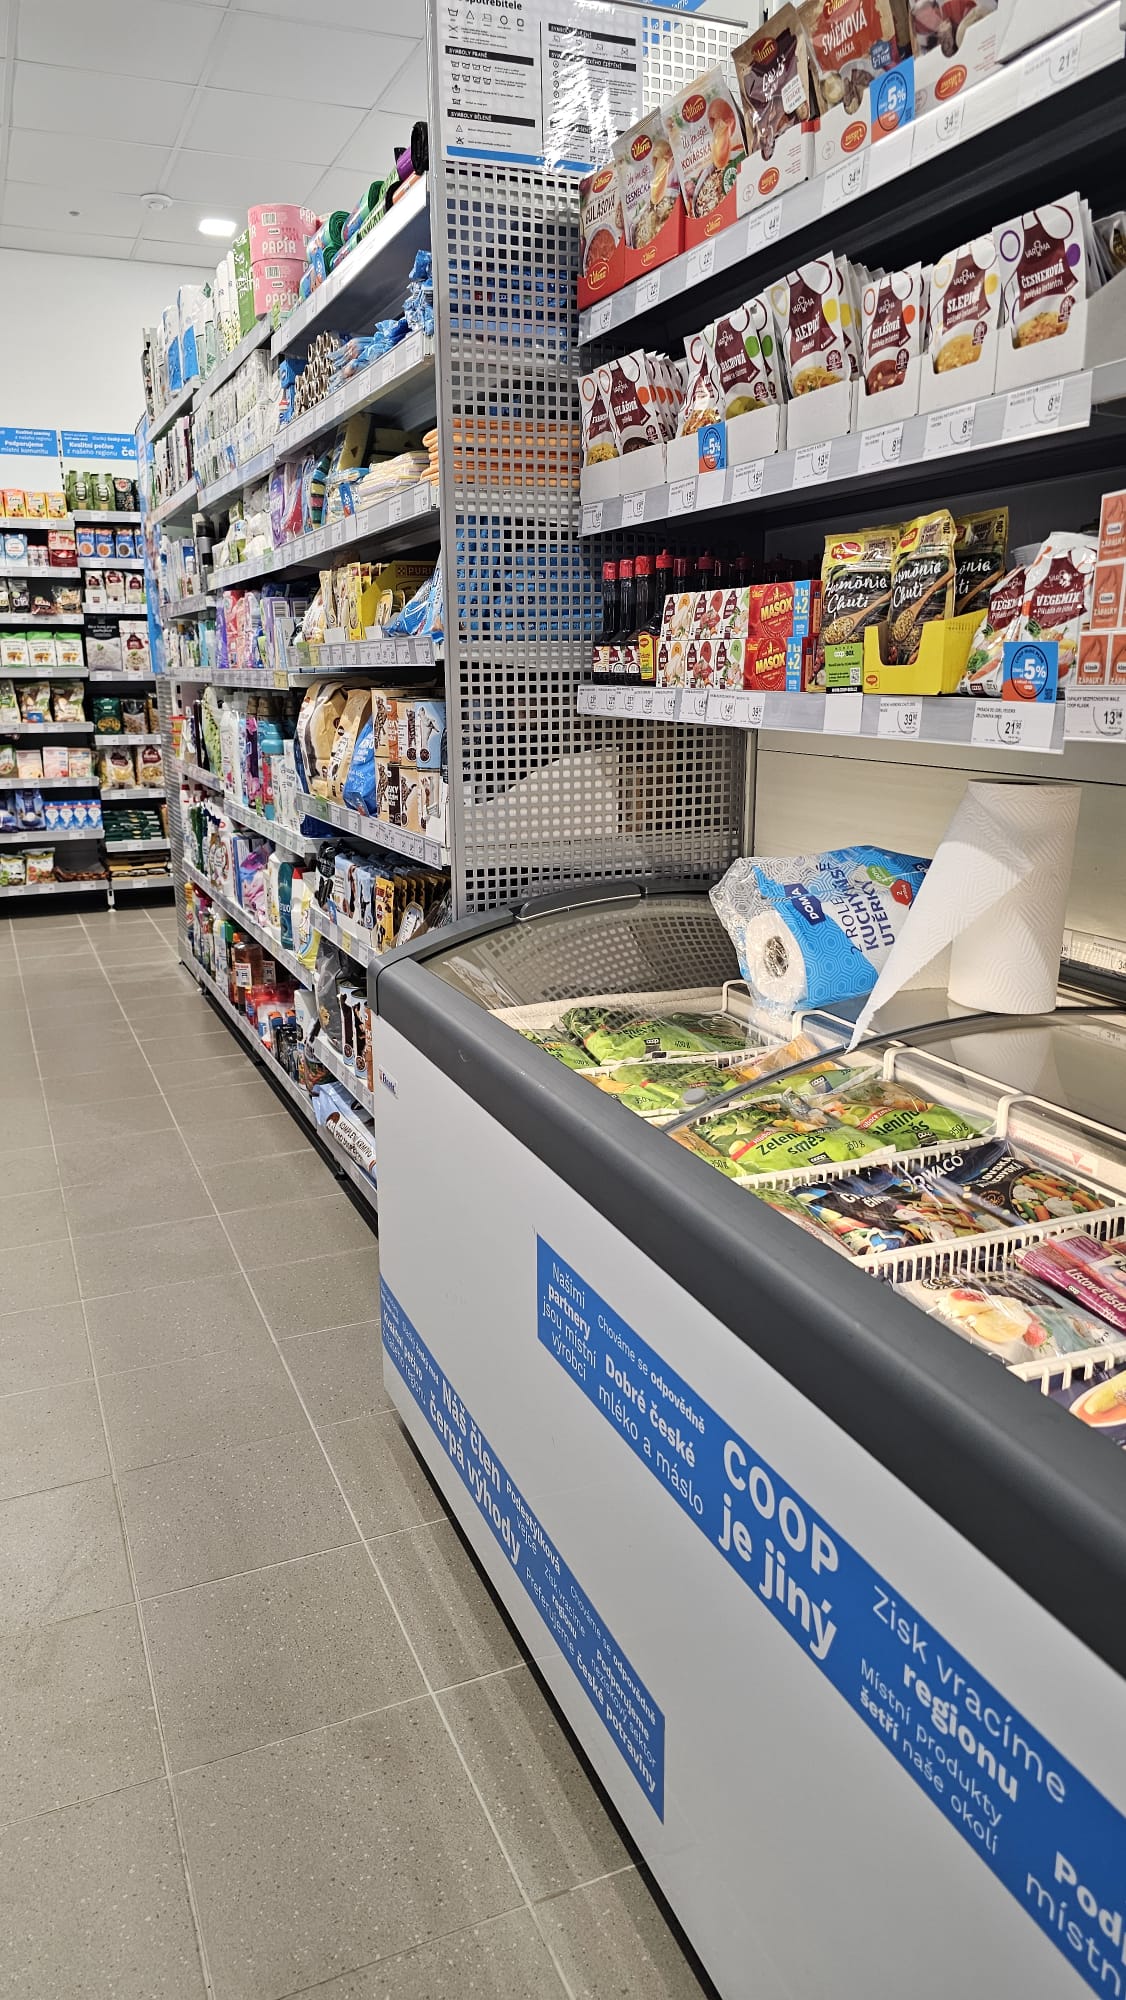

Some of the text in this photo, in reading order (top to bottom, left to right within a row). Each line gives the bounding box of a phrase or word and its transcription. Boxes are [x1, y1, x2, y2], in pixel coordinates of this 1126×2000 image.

[821, 1, 868, 56] SVÍČKOVÁ
[886, 85, 907, 110] 5%
[1021, 257, 1065, 290] ČESNEKOVÁ
[4, 440, 44, 449] Podporujeme
[69, 441, 93, 449] Kvalitní
[408, 566, 432, 575] PURI
[760, 596, 793, 622] MASOX
[795, 596, 809, 615] +2
[828, 593, 869, 614] Chuti
[991, 594, 1025, 611] VEGEM
[1036, 590, 1081, 606] VEGEMIX
[755, 651, 787, 675] MASOX
[787, 653, 800, 670] +2
[1023, 658, 1047, 681] 5%
[791, 887, 820, 921] DOMA
[830, 896, 859, 939] ROLE
[857, 880, 896, 947] UTĚRKY
[850, 943, 864, 955] 2
[787, 1134, 827, 1156] směs
[914, 1153, 965, 1186] OWACO
[547, 1283, 591, 1341] partnery
[551, 1261, 586, 1310] Našimi
[541, 1295, 597, 1369] jsou místní
[551, 1330, 587, 1382] výrobci
[597, 1312, 705, 1435] Chováme se odpovědně
[442, 1378, 501, 1493] Náš člen
[604, 1353, 695, 1469] Dobré české
[599, 1383, 704, 1515] mléko a máslo
[429, 1389, 521, 1566] čerpá výhody
[505, 1479, 562, 1577] Podestýlková
[723, 1439, 839, 1576] COOP
[516, 1514, 538, 1557] vejce
[543, 1565, 586, 1638] Zisk vracíme
[718, 1492, 838, 1661] je jiný
[551, 1592, 578, 1641] regionu
[525, 1565, 657, 1795] Preferujeme české potraviny
[570, 1584, 657, 1727] Chováme se odpovědně
[590, 1656, 657, 1769] neziskový sektor
[596, 1647, 650, 1742] Podporujeme
[872, 1583, 1066, 1805] Zisk vracíme
[860, 1657, 1002, 1827] Místní produkty
[902, 1663, 1018, 1803] regionu
[859, 1684, 998, 1856] šetří naše okolí
[1054, 1849, 1126, 1968] Pod
